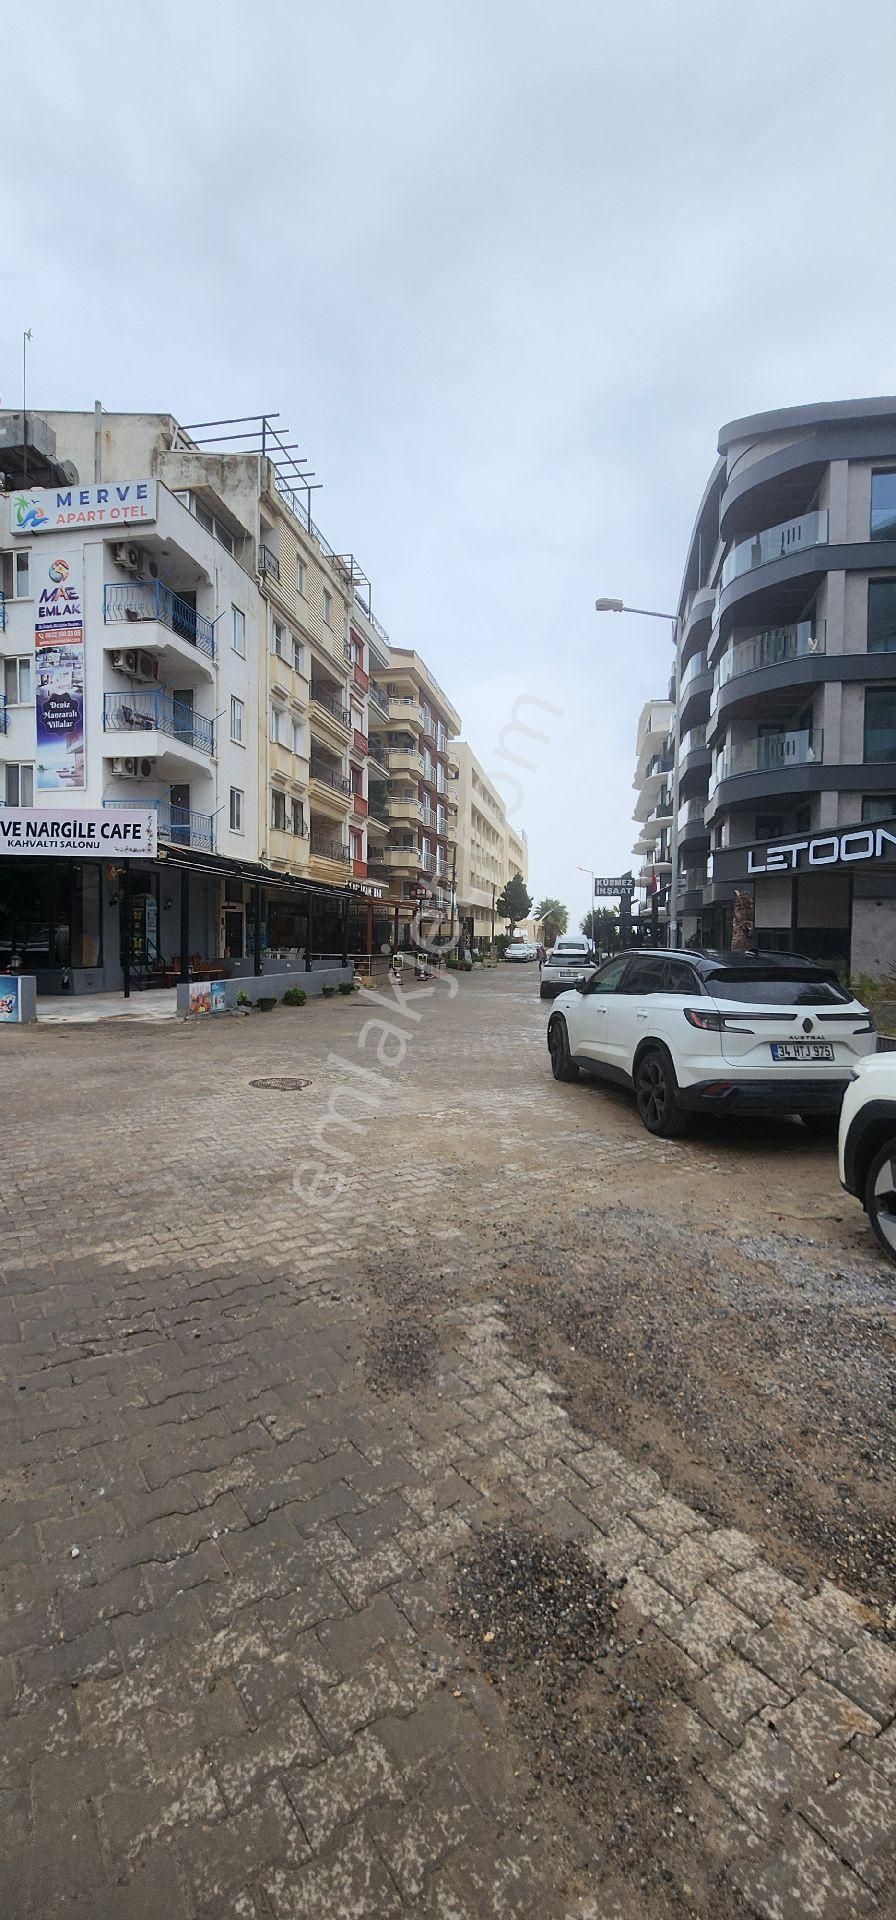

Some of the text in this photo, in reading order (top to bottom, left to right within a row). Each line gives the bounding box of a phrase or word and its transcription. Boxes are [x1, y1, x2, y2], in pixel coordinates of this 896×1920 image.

[56, 484, 148, 508] MERVE
[56, 505, 148, 525] APART OTEL
[39, 586, 80, 604] MAE
[38, 604, 82, 618] EMLAK
[50, 701, 71, 709] Deniz
[47, 720, 74, 729] Villalar
[26, 820, 96, 838] NARGİLE
[101, 823, 142, 839] CAFE
[8, 839, 100, 849] KAHVALTI SALONU
[596, 887, 633, 895] İNŞAAT
[778, 1045, 831, 1057] 34 HTJ 975
